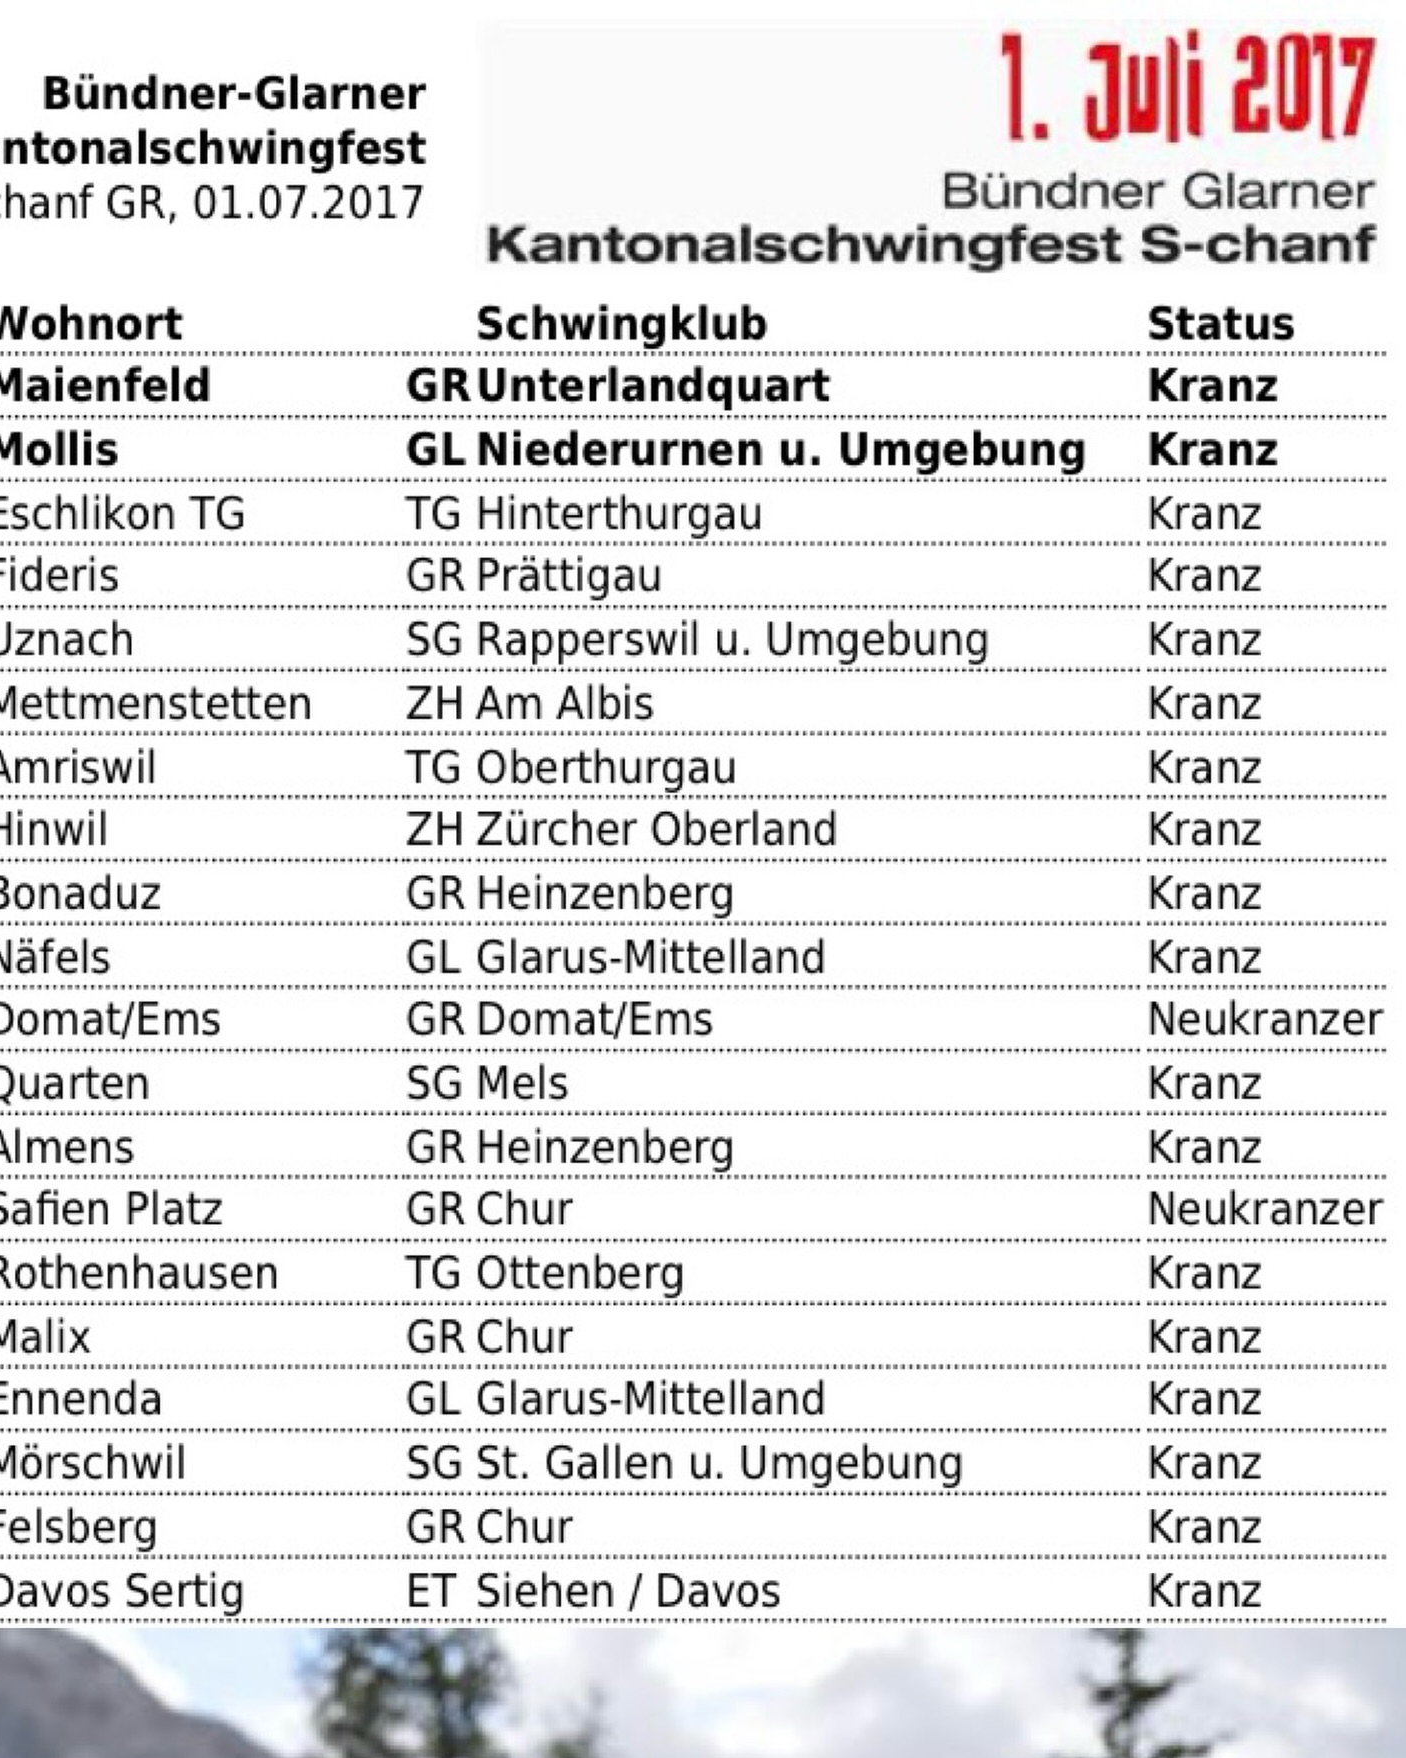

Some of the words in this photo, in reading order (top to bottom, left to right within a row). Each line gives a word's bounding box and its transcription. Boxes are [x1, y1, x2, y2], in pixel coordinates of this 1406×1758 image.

[44, 73, 426, 110] Bündner-Glarner
[1002, 33, 1048, 141] 1.
[1085, 29, 1203, 143] Juli
[1232, 33, 1376, 141] 2017
[107, 184, 176, 224] GR,
[194, 184, 423, 219] 01.07.2017
[944, 172, 1166, 209] Bündner
[1184, 171, 1376, 209] Glarner
[488, 223, 1123, 273] Kantonalschwingfest
[1142, 223, 1377, 264] S-chanf
[478, 304, 767, 349] Schwingklub
[1149, 305, 1294, 341] Status
[478, 365, 831, 411] Unterlandquart
[1149, 367, 1278, 402] Kranz
[478, 429, 762, 466] Niederurnen
[781, 439, 820, 466] u.
[840, 429, 1085, 475] Umgebung
[1149, 432, 1278, 466] Kranz
[189, 495, 244, 530] TG
[479, 494, 760, 539] Hinterthurgau
[1150, 496, 1261, 530] Kranz
[479, 555, 660, 601] Prättigau
[1150, 557, 1261, 592] Kranz
[479, 619, 697, 665] Rapperswil
[717, 629, 749, 656] u.
[767, 619, 988, 665] Umgebung
[1150, 621, 1261, 656] Kranz
[475, 685, 542, 719] Am
[556, 683, 654, 720] Albis
[1150, 685, 1261, 720] Kranz
[478, 748, 735, 793] Oberthurgau
[1150, 750, 1261, 784] Kranz
[477, 809, 637, 846] Zürcher
[651, 809, 836, 846] Oberland
[1150, 811, 1261, 846] Kranz
[479, 873, 732, 919] Heinzenberg
[1150, 875, 1261, 910] Kranz
[478, 938, 824, 974] Glarus-Mittelland
[1150, 939, 1261, 974] Kranz
[479, 1001, 713, 1039] Domat/Ems
[1150, 999, 1384, 1036] Neukranzer
[479, 1063, 568, 1100] Mels
[1150, 1065, 1261, 1100] Kranz
[479, 1127, 732, 1173] Heinzenberg
[1150, 1129, 1261, 1164] Kranz
[128, 1189, 222, 1225] Platz
[478, 1189, 573, 1225] Chur
[1150, 1189, 1384, 1225] Neukranzer
[478, 1253, 682, 1298] Ottenberg
[1150, 1255, 1261, 1289] Kranz
[478, 1317, 573, 1354] Chur
[1150, 1319, 1261, 1353] Kranz
[478, 1379, 824, 1416] Glarus-Mittelland
[1150, 1381, 1261, 1415] Kranz
[478, 1445, 528, 1480] St.
[546, 1443, 672, 1480] Gallen
[691, 1452, 723, 1480] u.
[741, 1443, 962, 1488] Umgebung
[1150, 1445, 1261, 1479] Kranz
[478, 1507, 573, 1544] Chur
[1150, 1509, 1261, 1544] Kranz
[126, 1571, 243, 1616] Sertig
[478, 1571, 613, 1608] Siehen
[628, 1573, 643, 1612] /
[658, 1573, 780, 1608] Davos
[1150, 1573, 1261, 1607] Kranz
